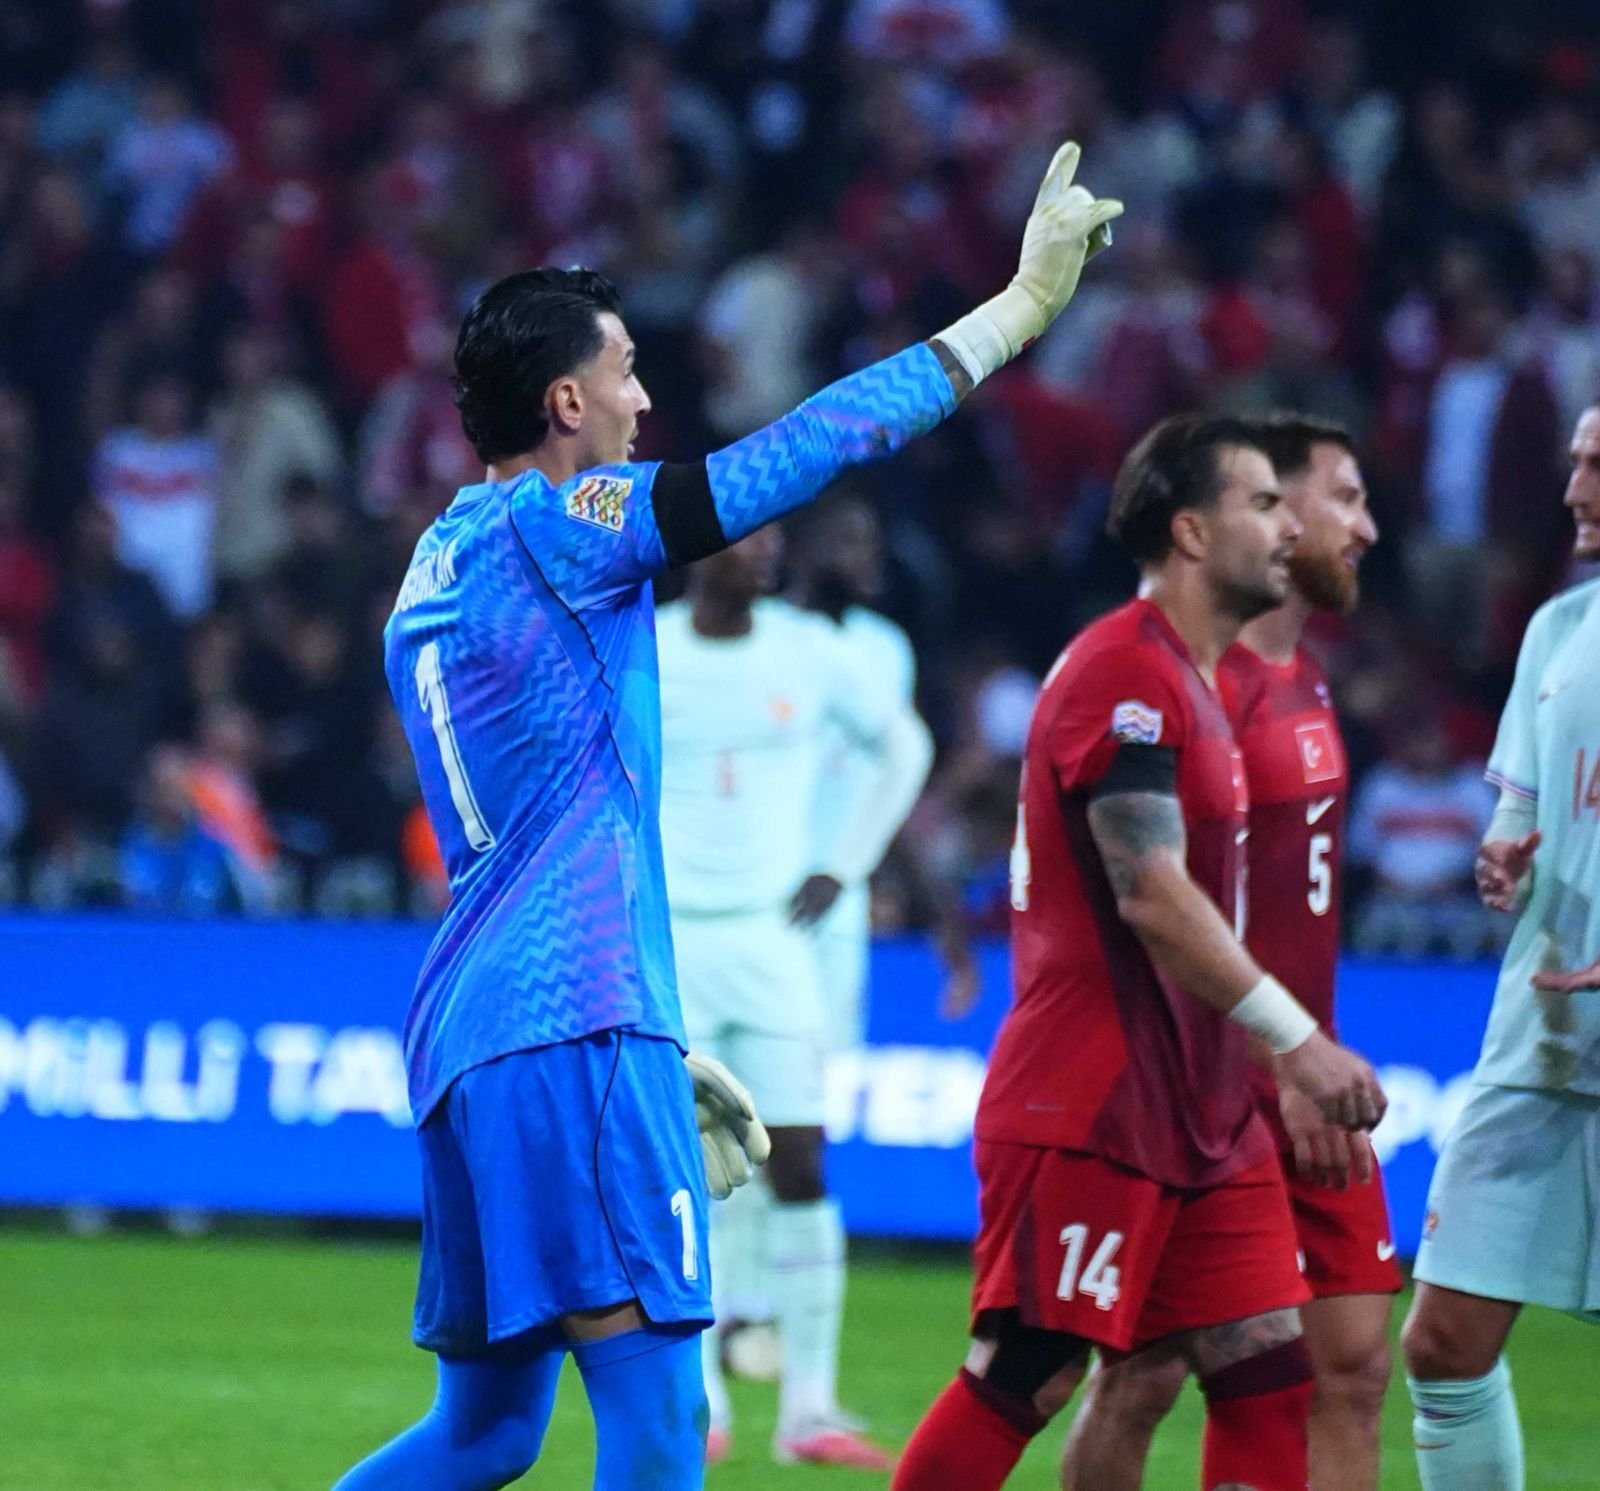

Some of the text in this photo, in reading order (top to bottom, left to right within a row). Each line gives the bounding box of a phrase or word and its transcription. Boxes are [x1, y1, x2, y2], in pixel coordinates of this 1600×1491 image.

[414, 642, 496, 852] 1
[1307, 833, 1332, 916] 5
[256, 1022, 414, 1128] TA
[671, 1189, 698, 1281] 1
[1056, 1222, 1125, 1311] 14
